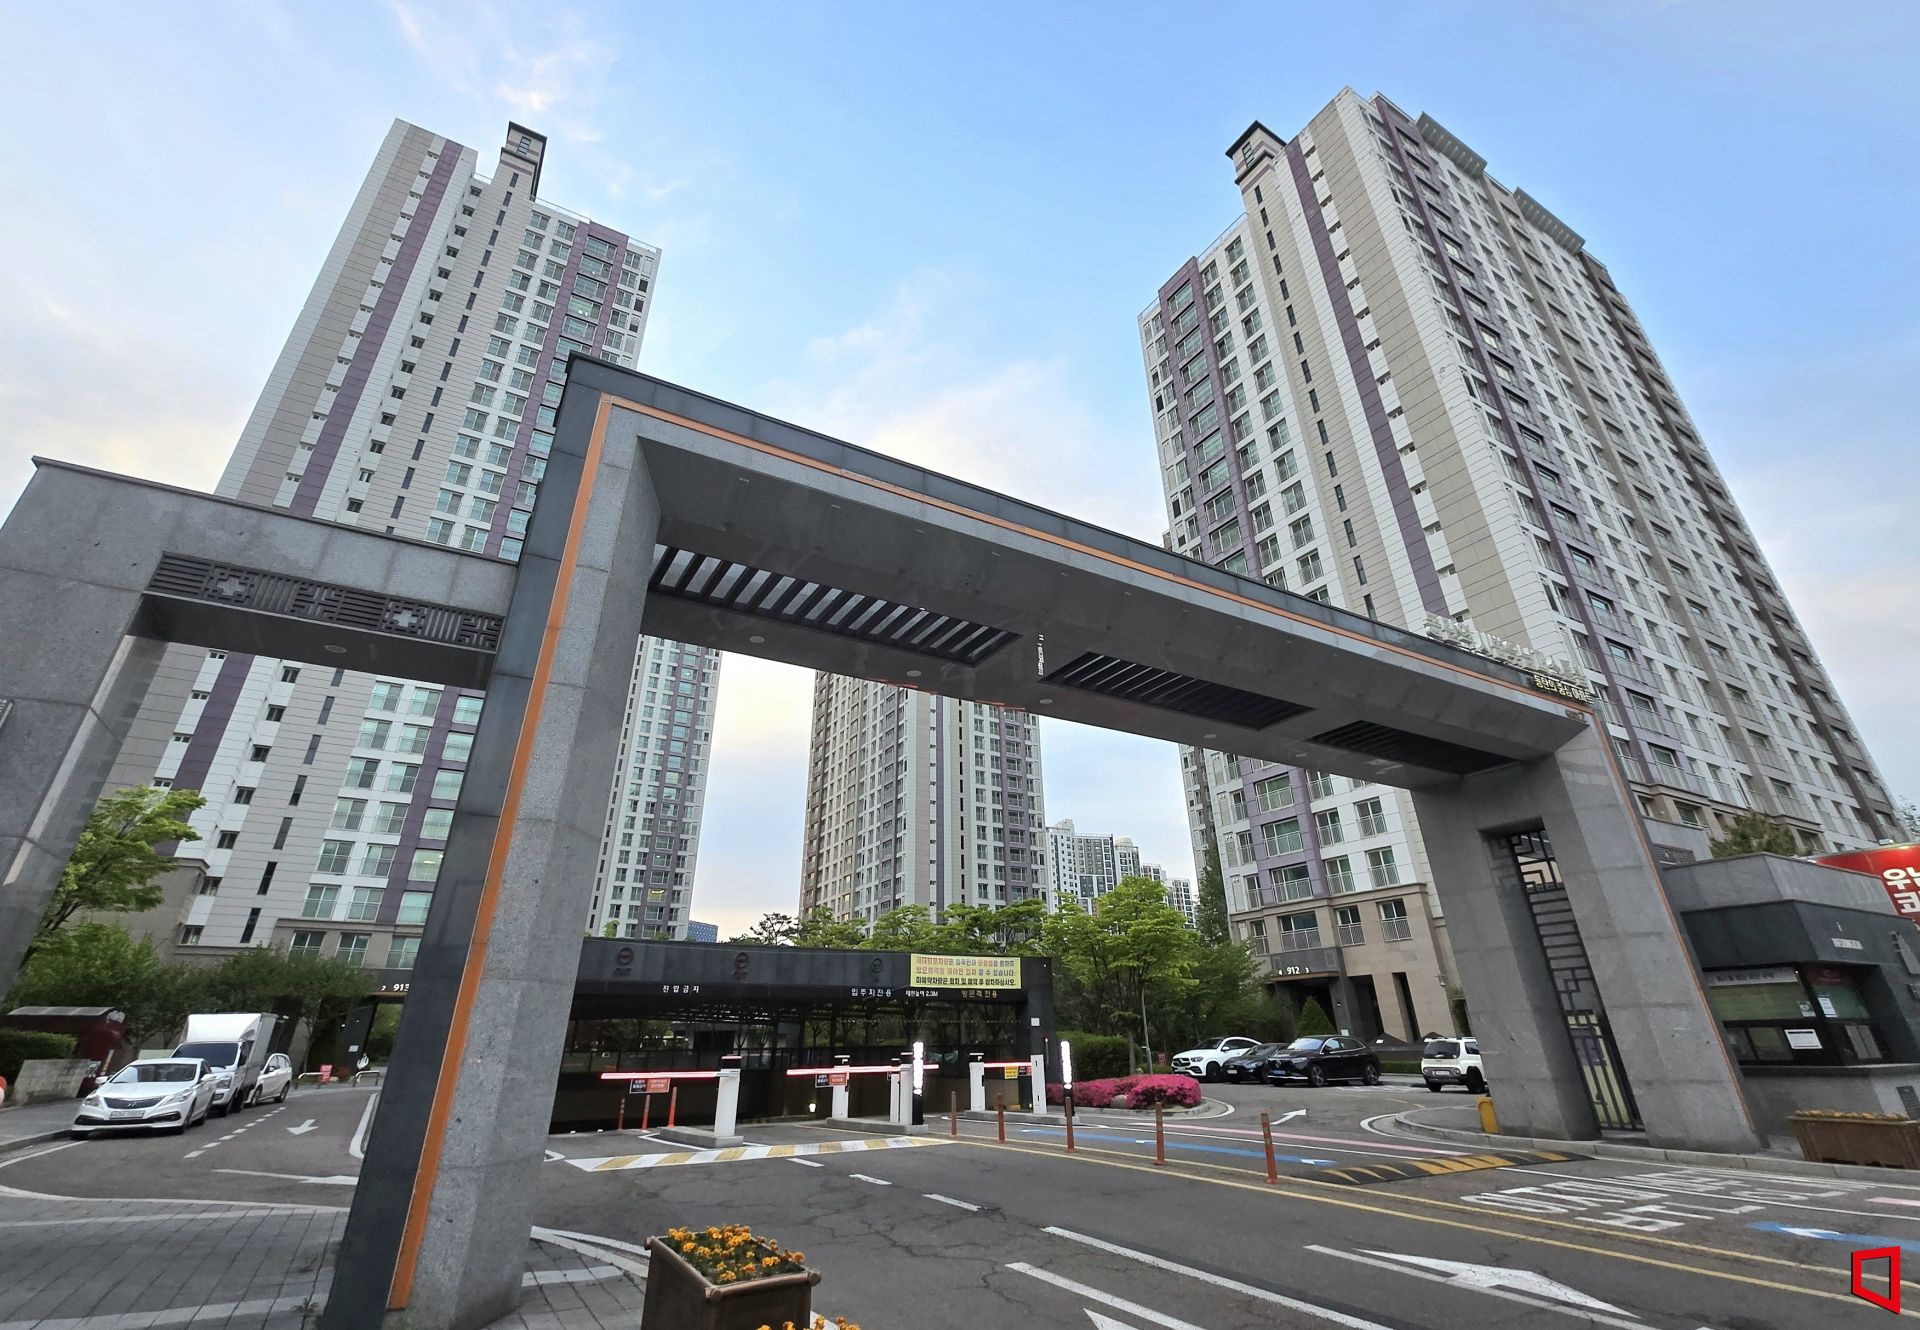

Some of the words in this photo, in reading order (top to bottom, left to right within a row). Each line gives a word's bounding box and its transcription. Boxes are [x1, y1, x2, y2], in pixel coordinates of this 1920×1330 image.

[986, 969, 991, 977] 수
[1286, 966, 1300, 975] 912
[979, 978, 984, 986] 후
[663, 985, 699, 993] 진입금지
[852, 988, 892, 998] 입주자전용
[962, 990, 997, 998] 방문객전용
